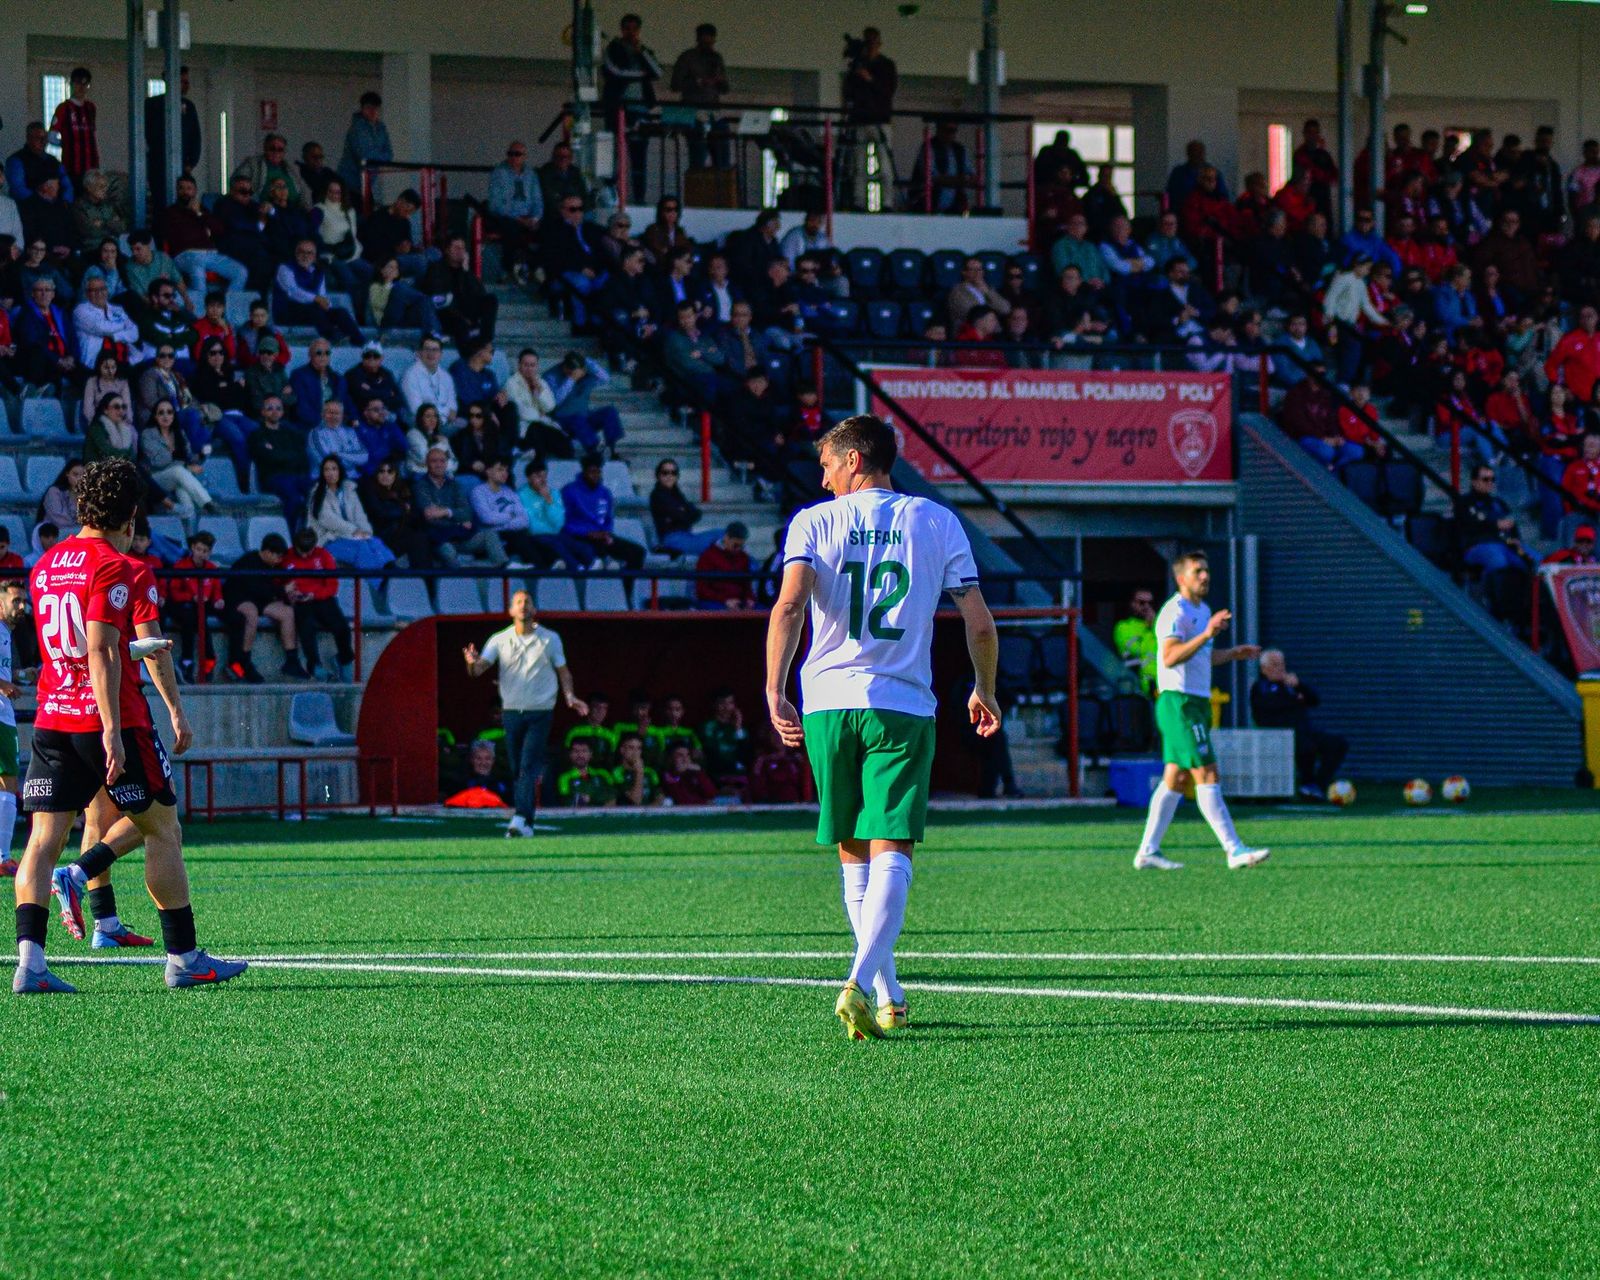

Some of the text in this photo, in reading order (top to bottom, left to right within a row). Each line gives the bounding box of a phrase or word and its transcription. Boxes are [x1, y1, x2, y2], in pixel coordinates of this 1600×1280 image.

[880, 380, 987, 399] BIENVENIDOS
[990, 380, 1011, 400] AL
[1013, 381, 1081, 401] MANUEL
[1082, 381, 1167, 401] POLINARIO
[925, 416, 1158, 466] Territorio rojo y negro
[849, 530, 902, 545] STEFAN
[51, 551, 87, 568] LALO
[840, 560, 911, 641] 12
[39, 591, 88, 660] 20
